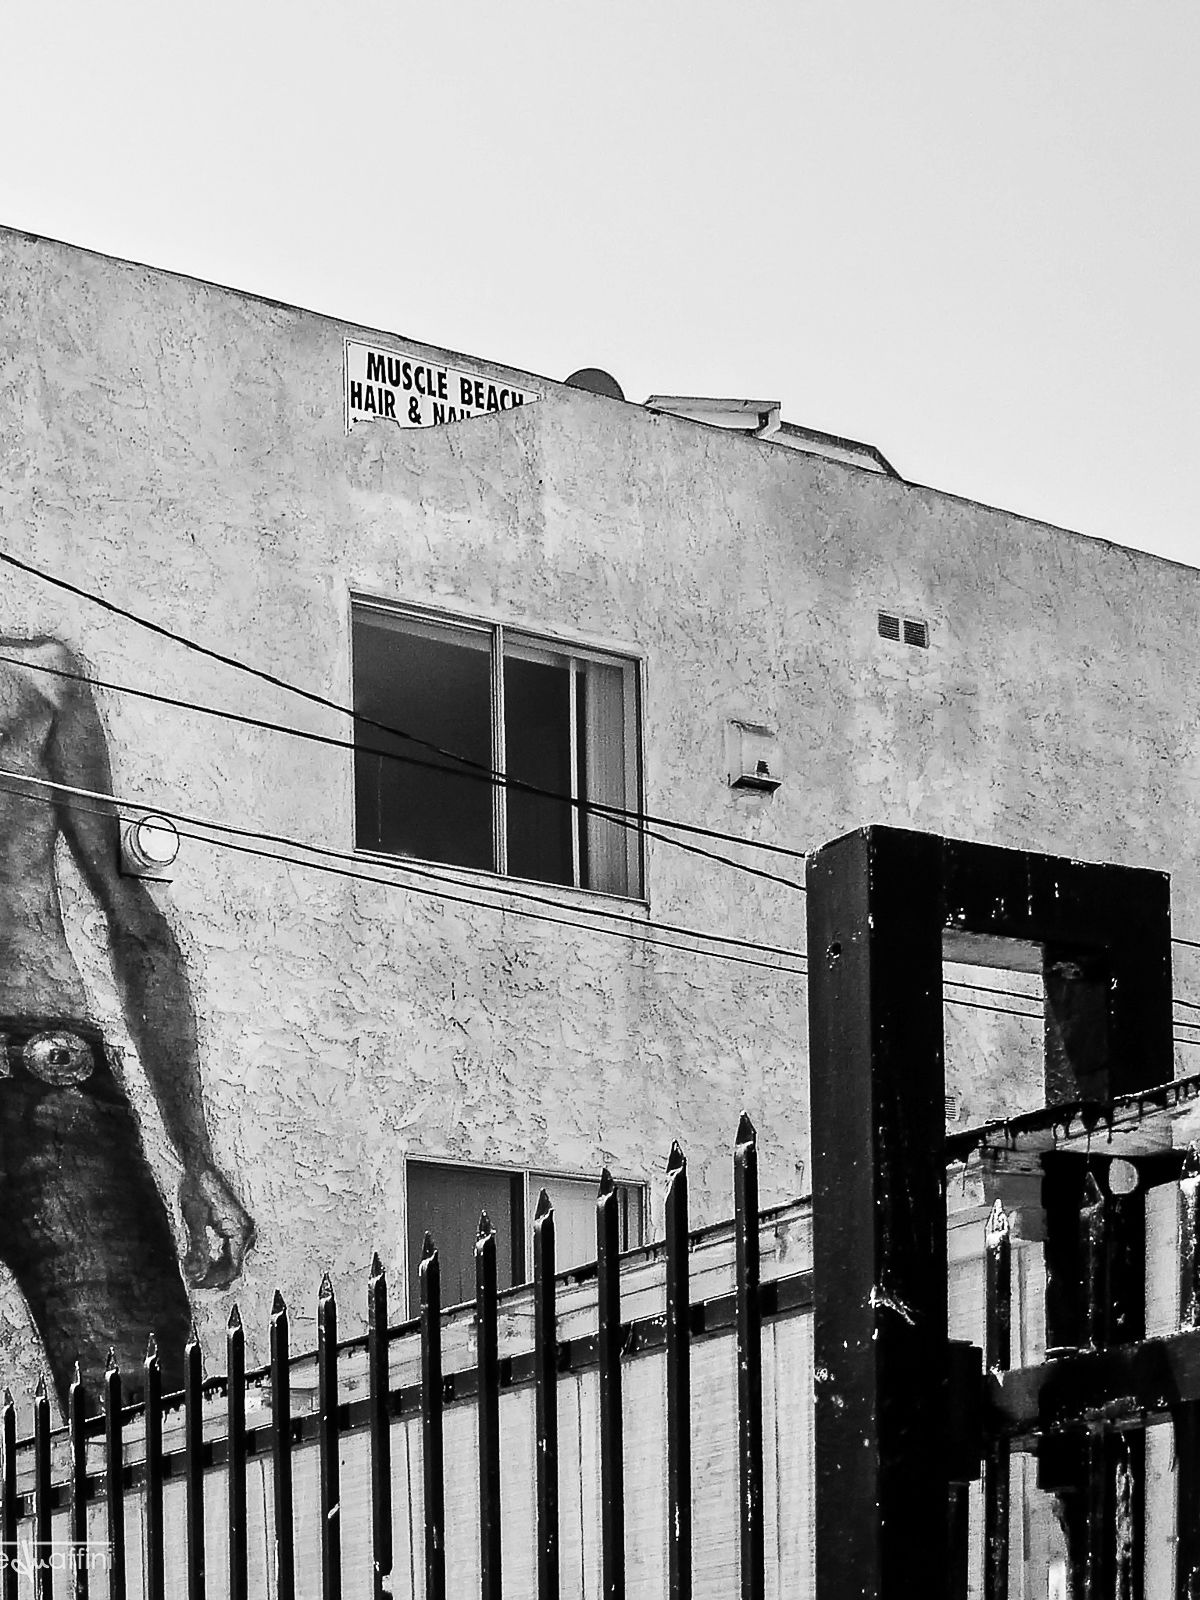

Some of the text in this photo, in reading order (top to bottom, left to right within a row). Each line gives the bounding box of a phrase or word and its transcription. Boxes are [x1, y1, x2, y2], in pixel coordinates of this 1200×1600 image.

[351, 380, 396, 418] HAIR
[408, 396, 422, 424] &
[367, 352, 523, 412] MUSCLE BEACH
